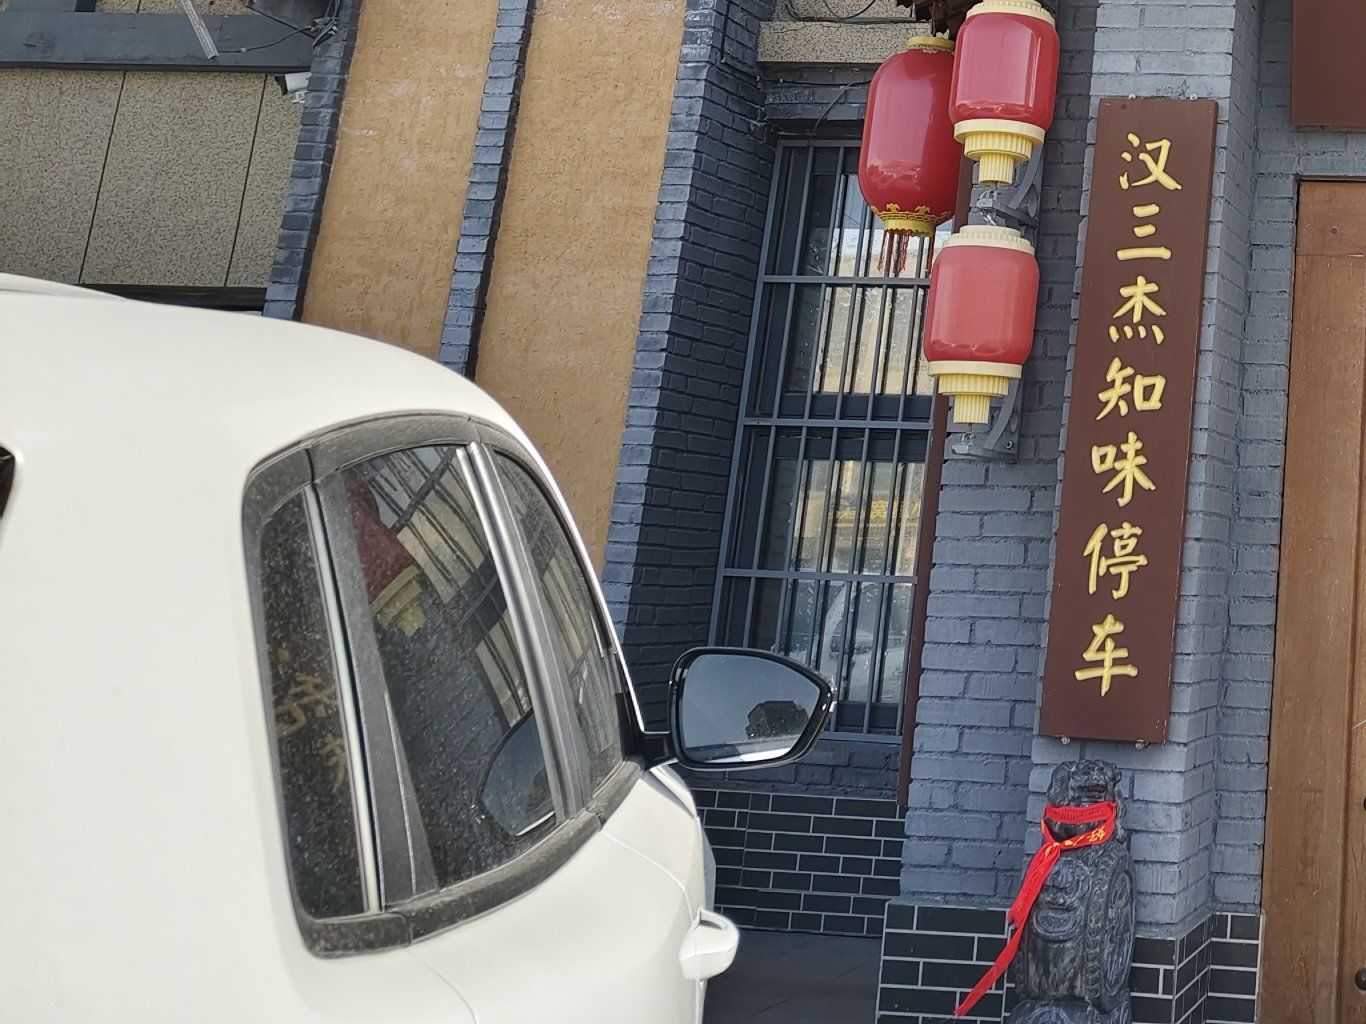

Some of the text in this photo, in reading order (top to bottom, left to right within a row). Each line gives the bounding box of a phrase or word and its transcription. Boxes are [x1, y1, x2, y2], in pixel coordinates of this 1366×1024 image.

[1074, 132, 1182, 697] 汉三杰知味停车
